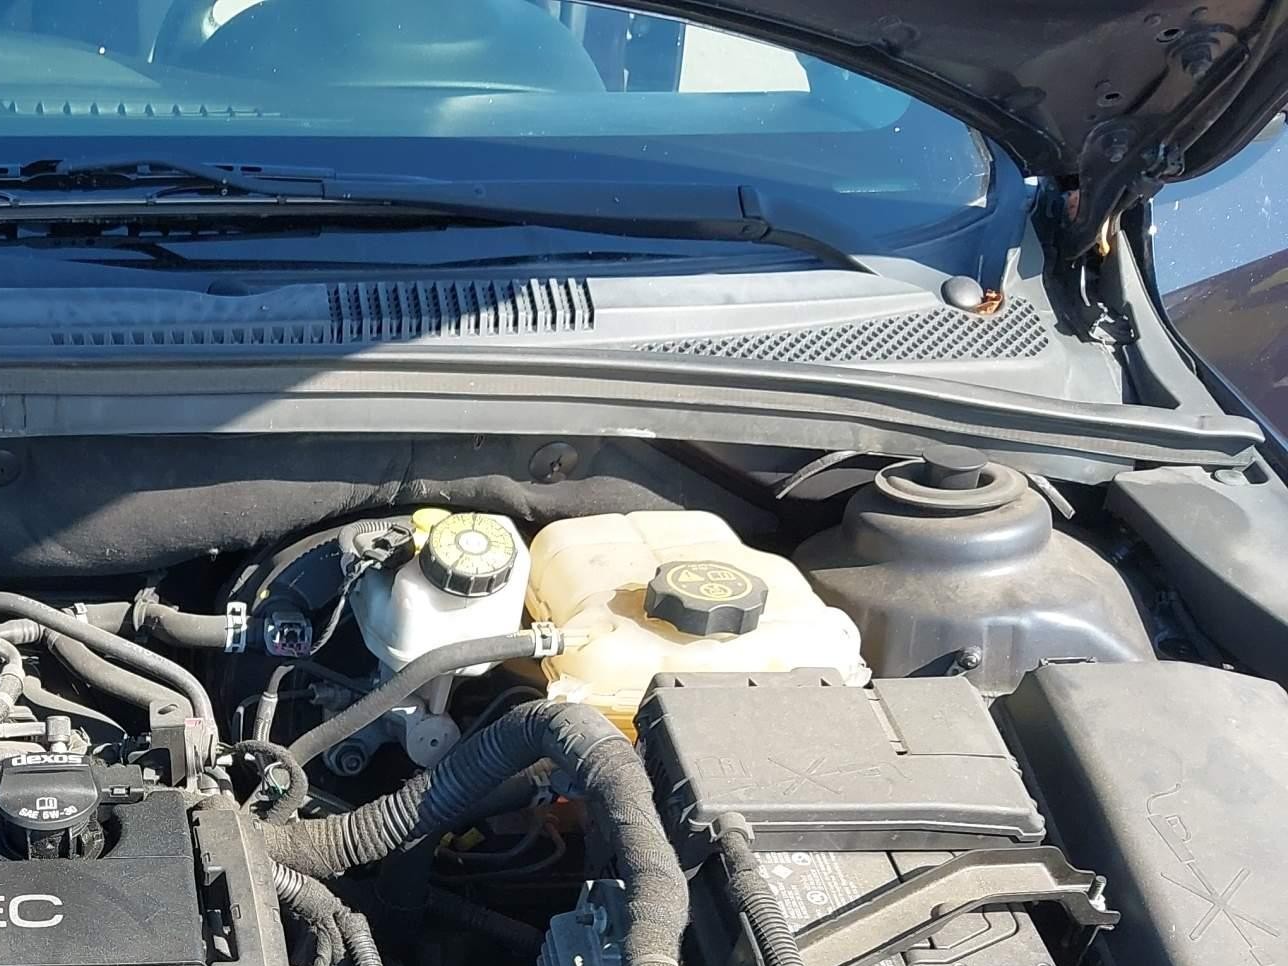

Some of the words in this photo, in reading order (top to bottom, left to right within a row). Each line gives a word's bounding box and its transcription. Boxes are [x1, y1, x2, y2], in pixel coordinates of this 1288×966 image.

[12, 754, 82, 766] dexos
[19, 807, 39, 820] SAE
[42, 805, 78, 820] 5W-30
